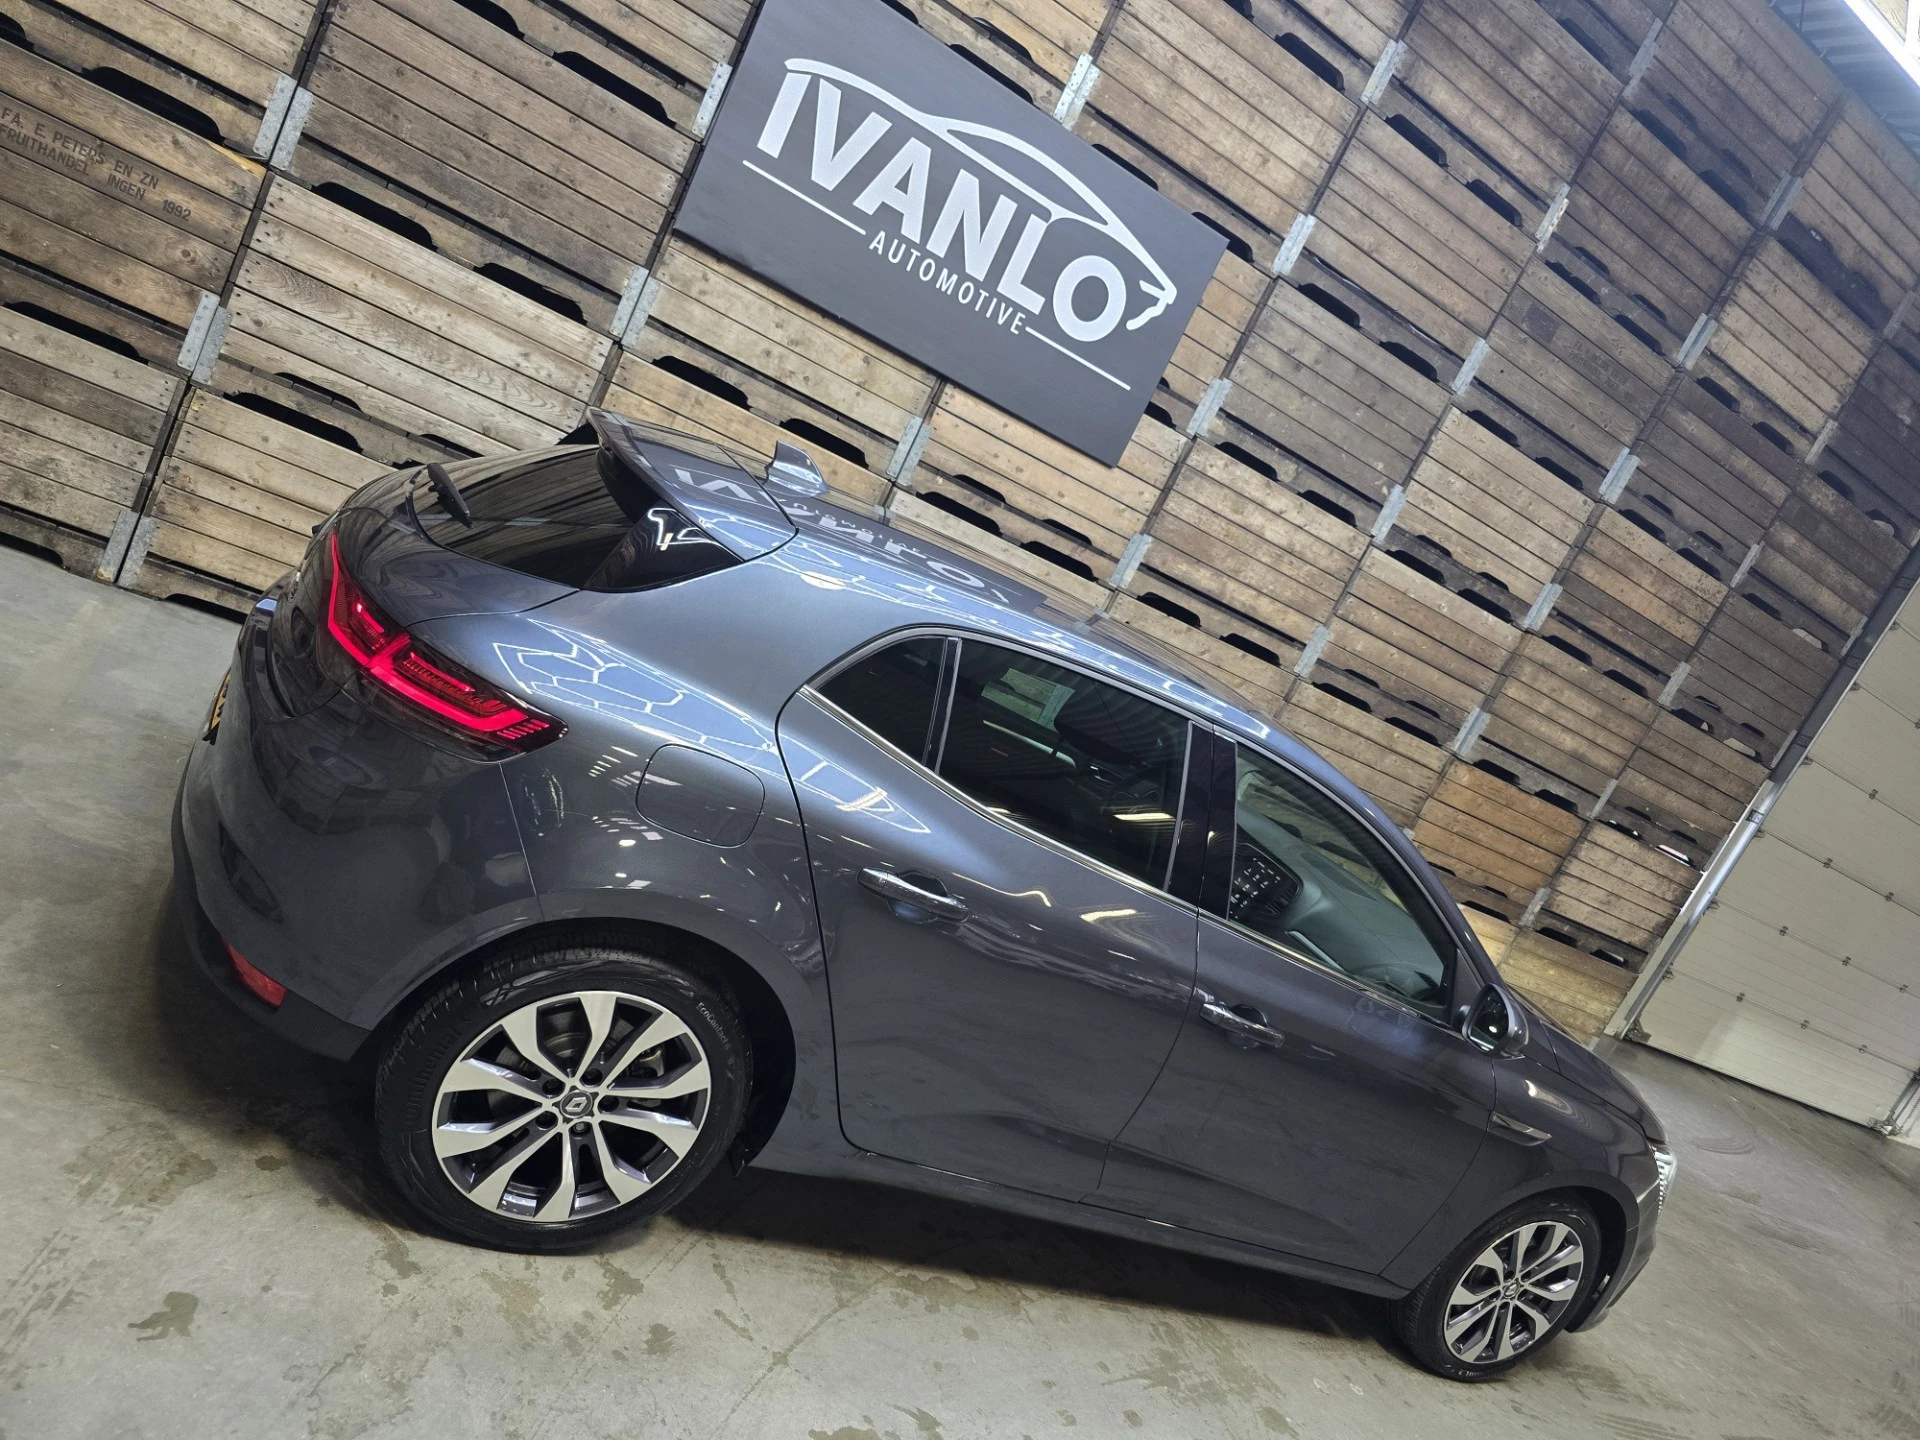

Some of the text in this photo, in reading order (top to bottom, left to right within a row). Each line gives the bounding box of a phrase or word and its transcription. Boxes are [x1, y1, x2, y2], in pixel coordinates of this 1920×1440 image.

[0, 123, 192, 222] FRUITHANDEL INGEN 1992
[52, 130, 106, 165] PETERS
[114, 160, 134, 178] EN
[140, 171, 159, 190] ZN
[757, 72, 1127, 342] IVANLO
[869, 230, 1026, 335] AUTOMOTIVE
